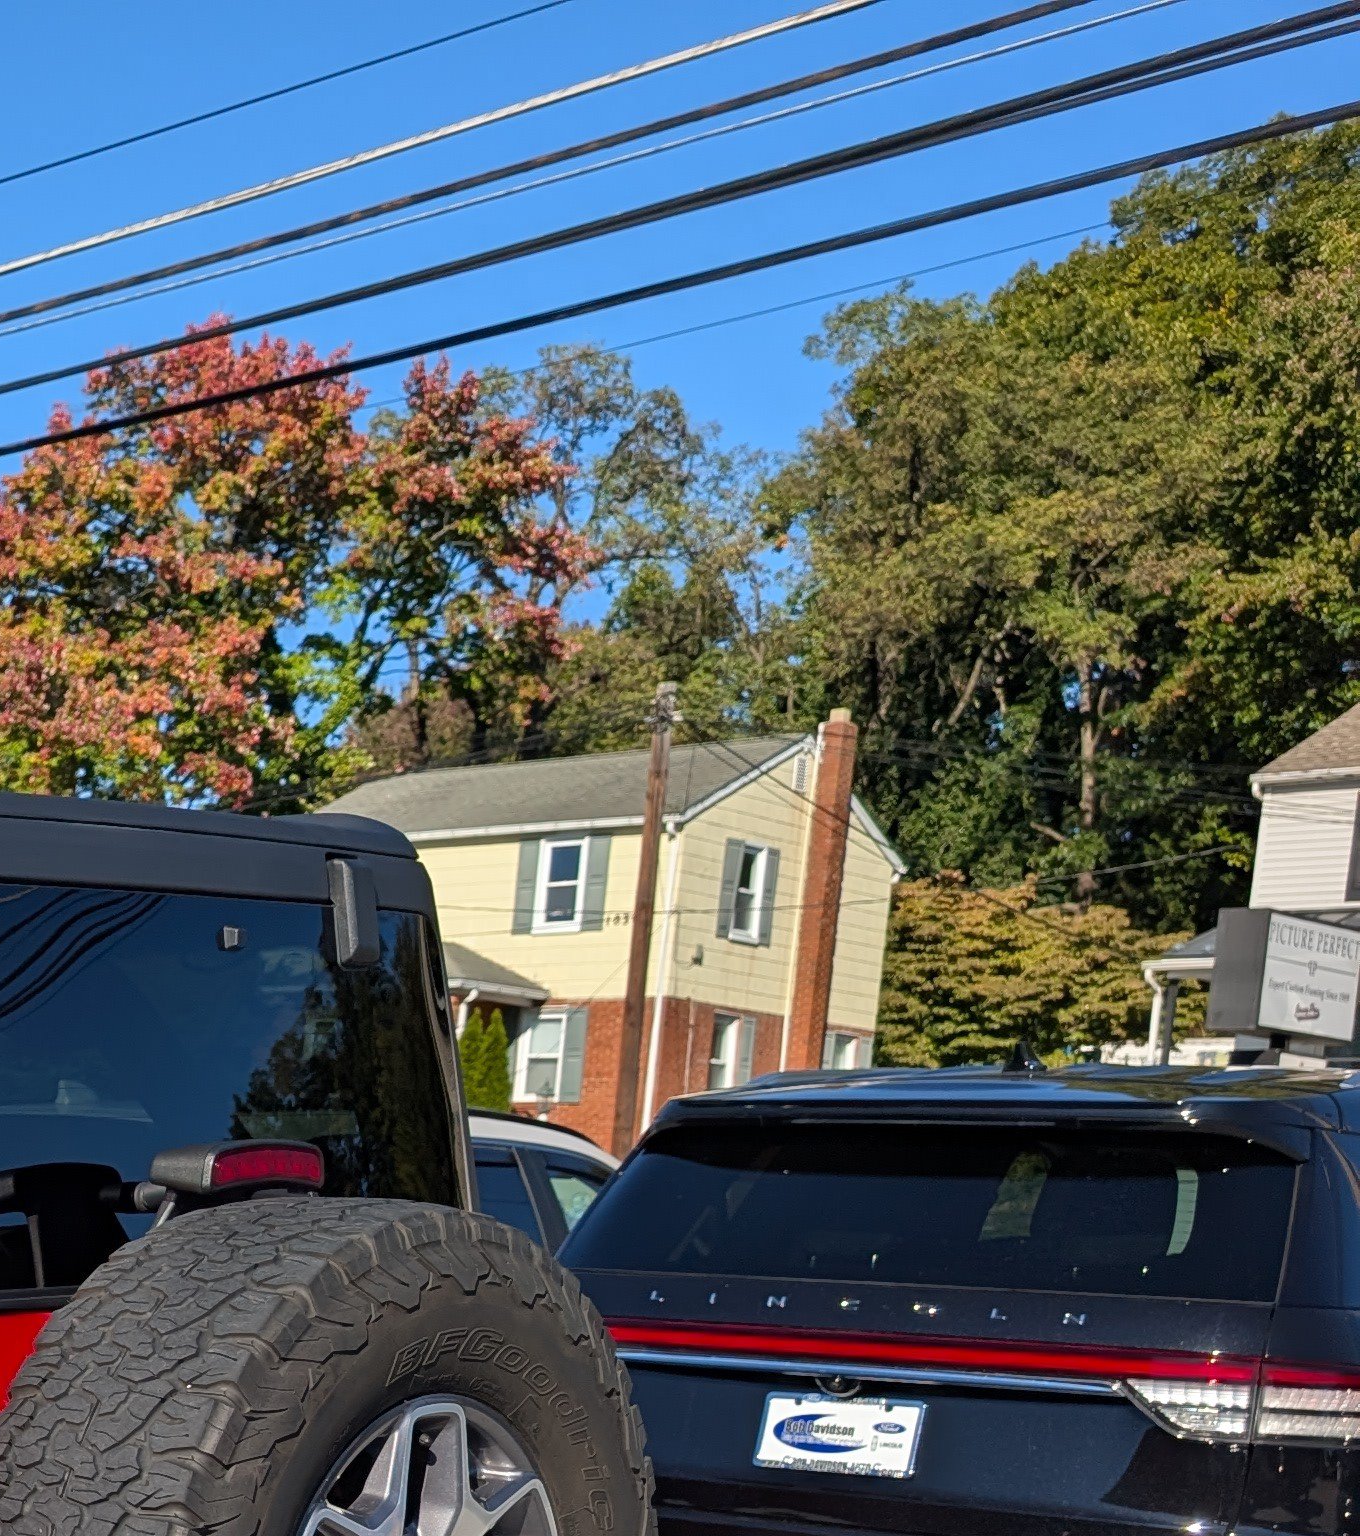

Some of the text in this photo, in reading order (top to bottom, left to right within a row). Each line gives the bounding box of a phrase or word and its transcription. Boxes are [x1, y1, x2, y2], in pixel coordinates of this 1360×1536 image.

[1270, 922, 1360, 960] PICTURE PERFECT
[650, 1290, 1086, 1325] LINCOLN
[785, 1419, 856, 1438] Bob Davidson
